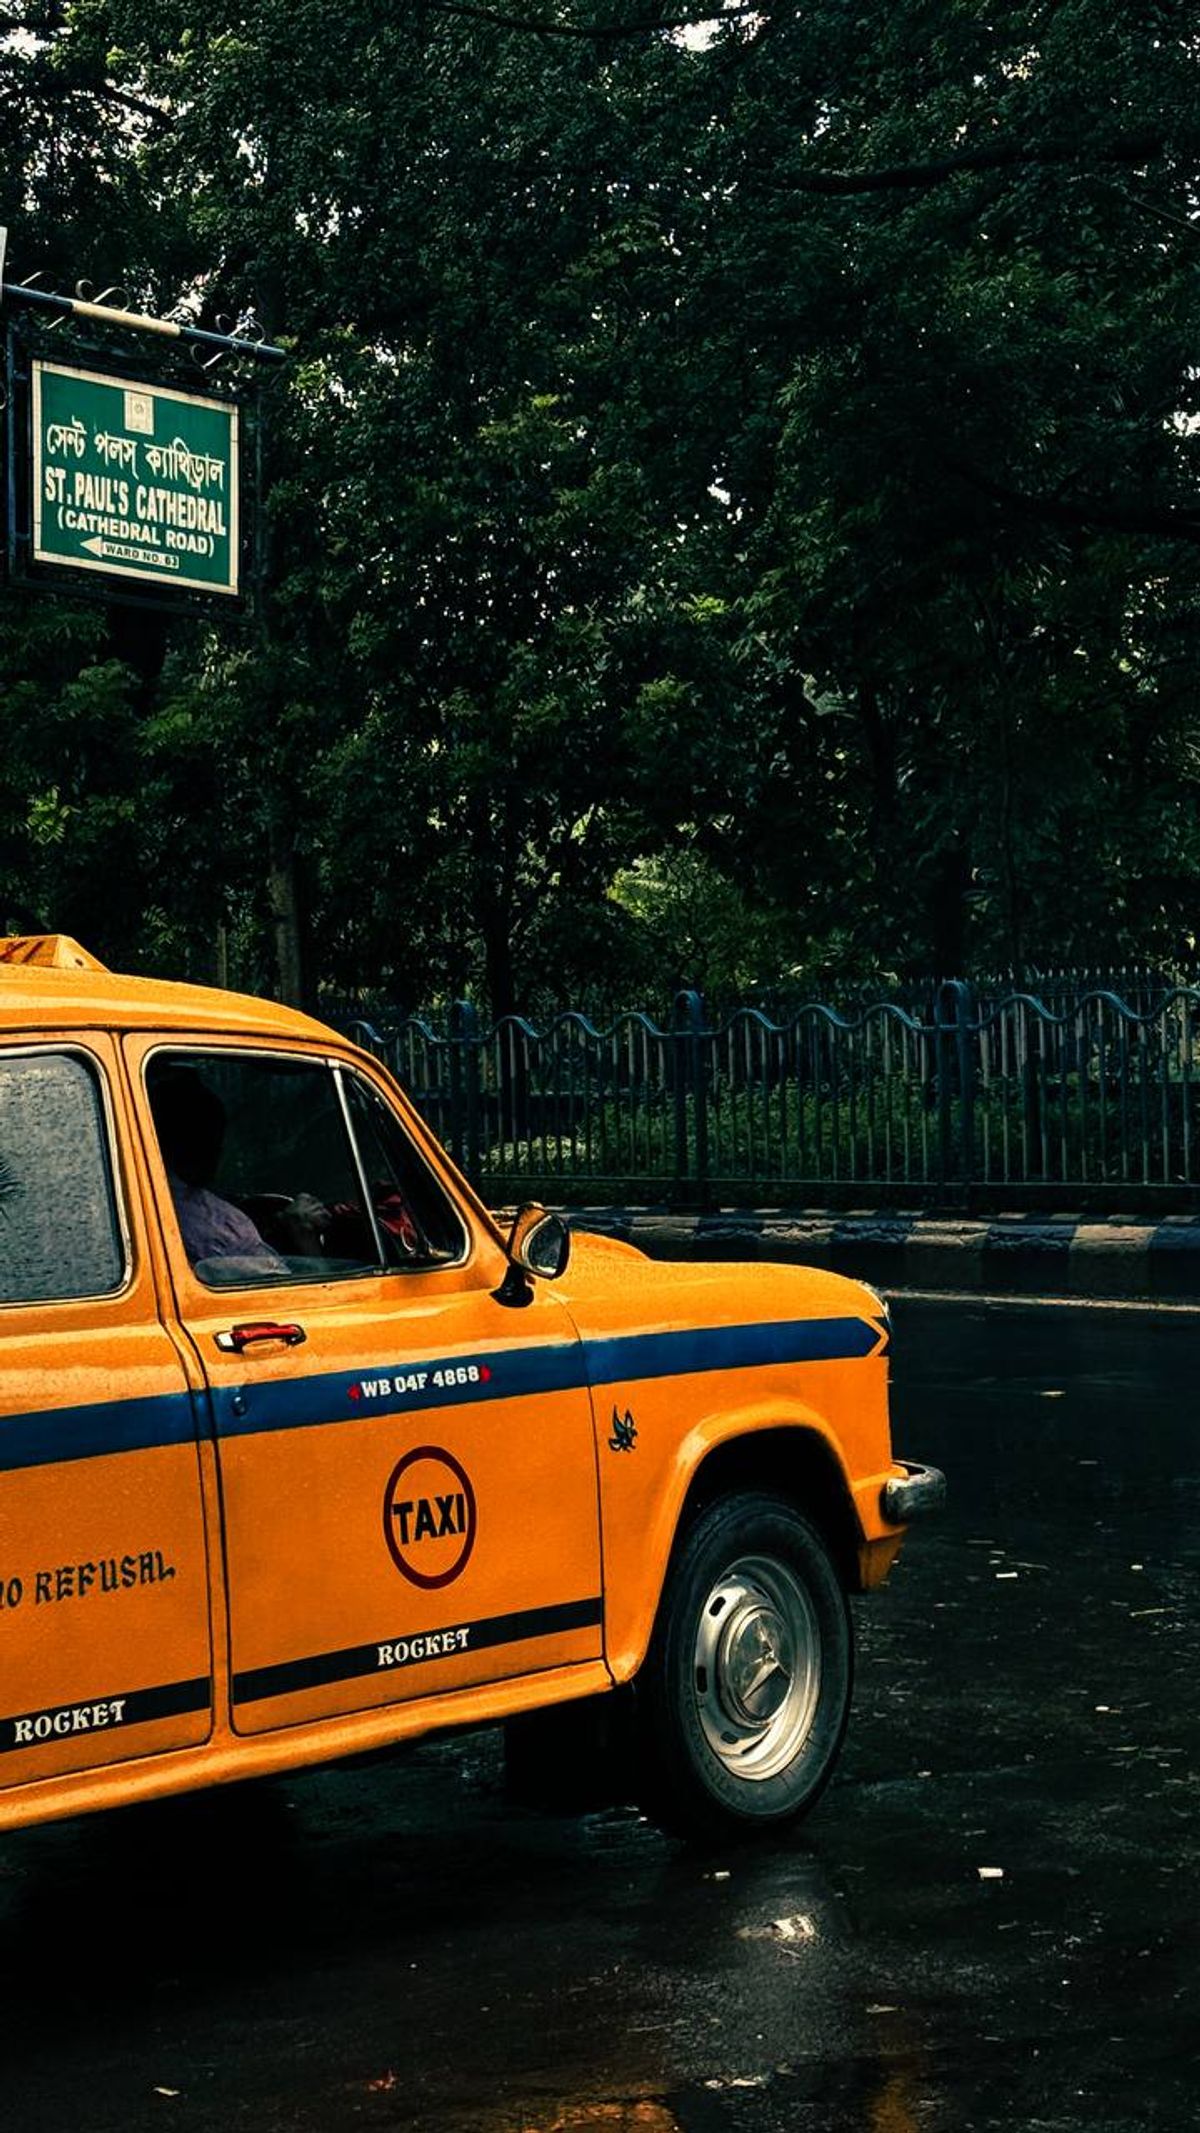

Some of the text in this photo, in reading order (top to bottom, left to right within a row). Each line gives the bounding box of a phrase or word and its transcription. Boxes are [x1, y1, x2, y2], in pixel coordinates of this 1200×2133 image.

[57, 506, 214, 558] (CATHEDRAL ROAD)
[135, 484, 227, 536] CATHEDRAL
[105, 544, 140, 560] WARD
[165, 555, 178, 567] 63
[360, 1365, 480, 1398] WB 04F 4868
[391, 1493, 466, 1545] TAXI
[0, 1551, 176, 1609] O REFUSAL
[376, 1628, 470, 1667] ROCKET
[13, 1699, 127, 1744] ROCKET
